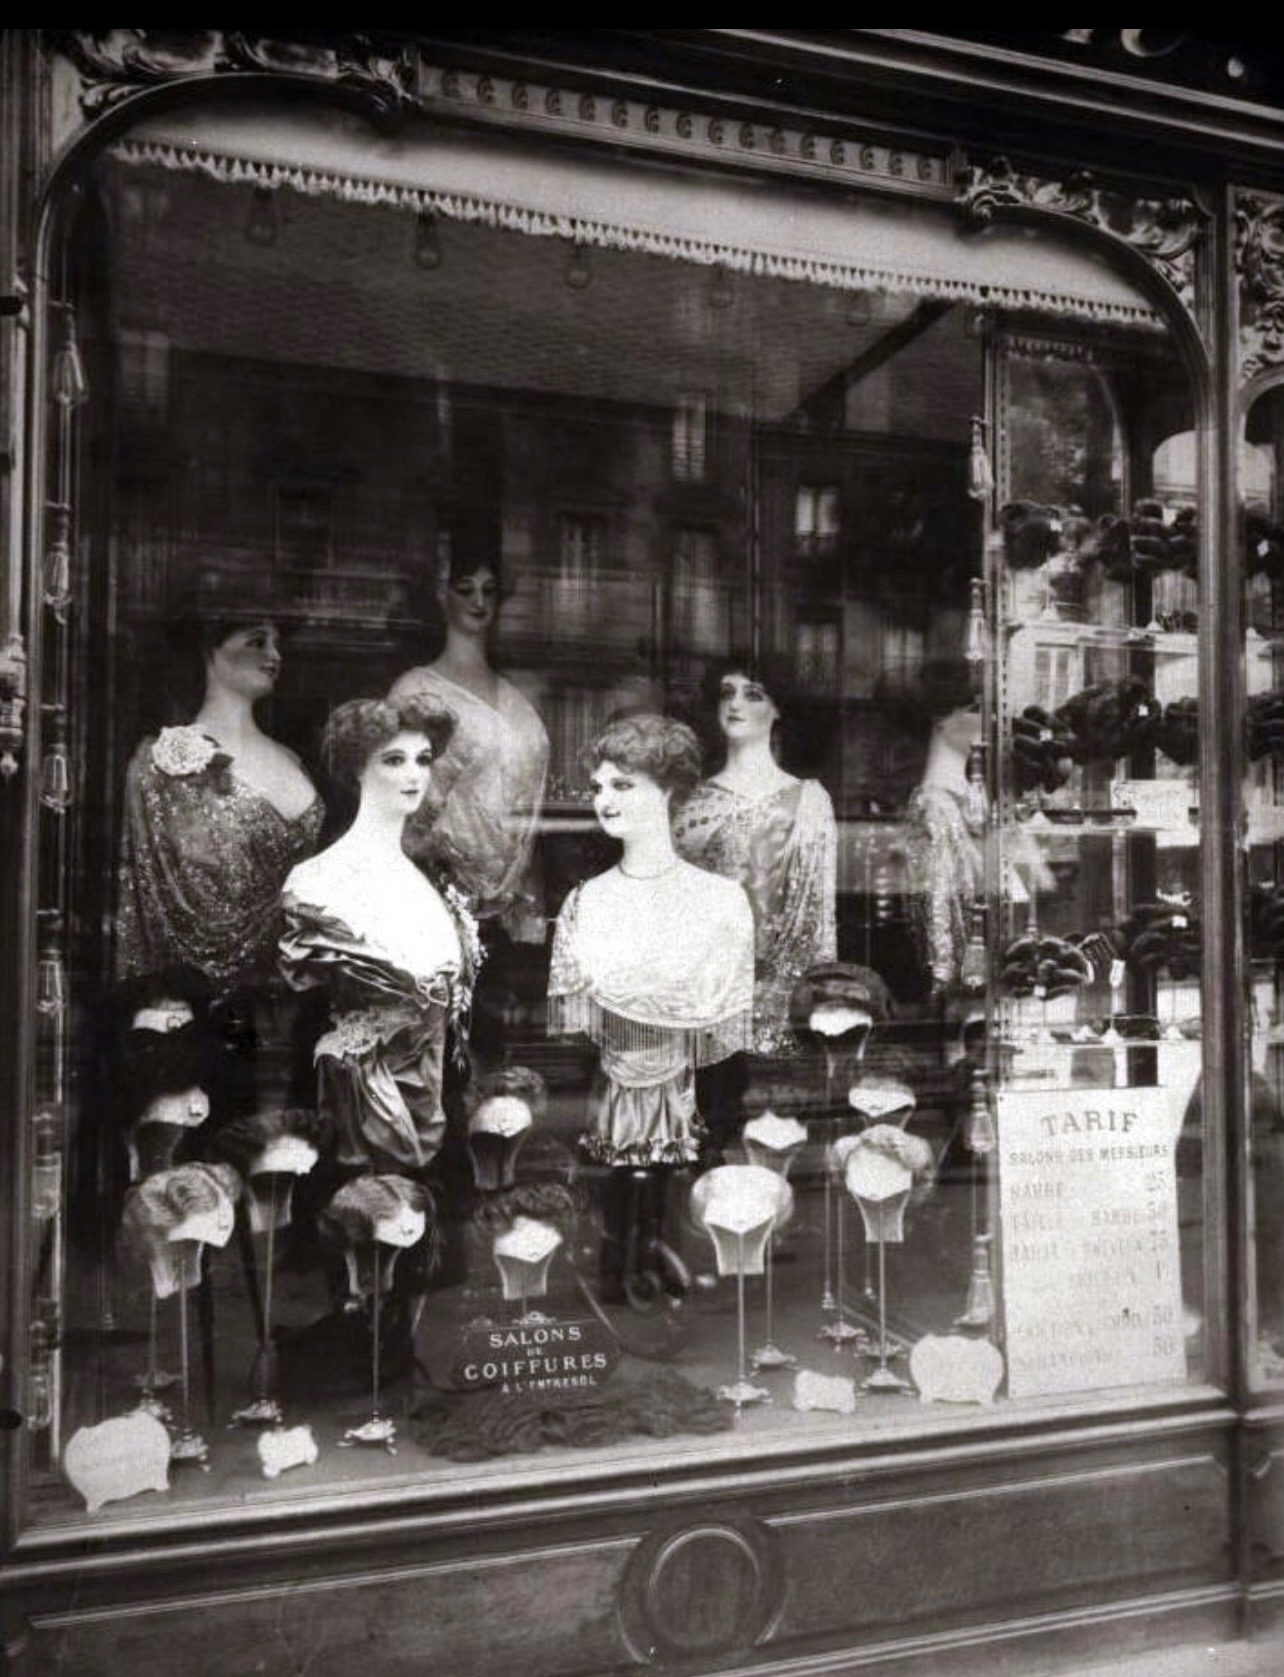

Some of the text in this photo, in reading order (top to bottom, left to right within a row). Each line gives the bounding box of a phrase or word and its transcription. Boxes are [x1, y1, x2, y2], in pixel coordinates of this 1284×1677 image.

[1040, 1109, 1138, 1137] TARIF
[1009, 1151, 1063, 1166] SALONS
[490, 1327, 581, 1348] SALONS
[464, 1353, 607, 1380] COIFFURES
